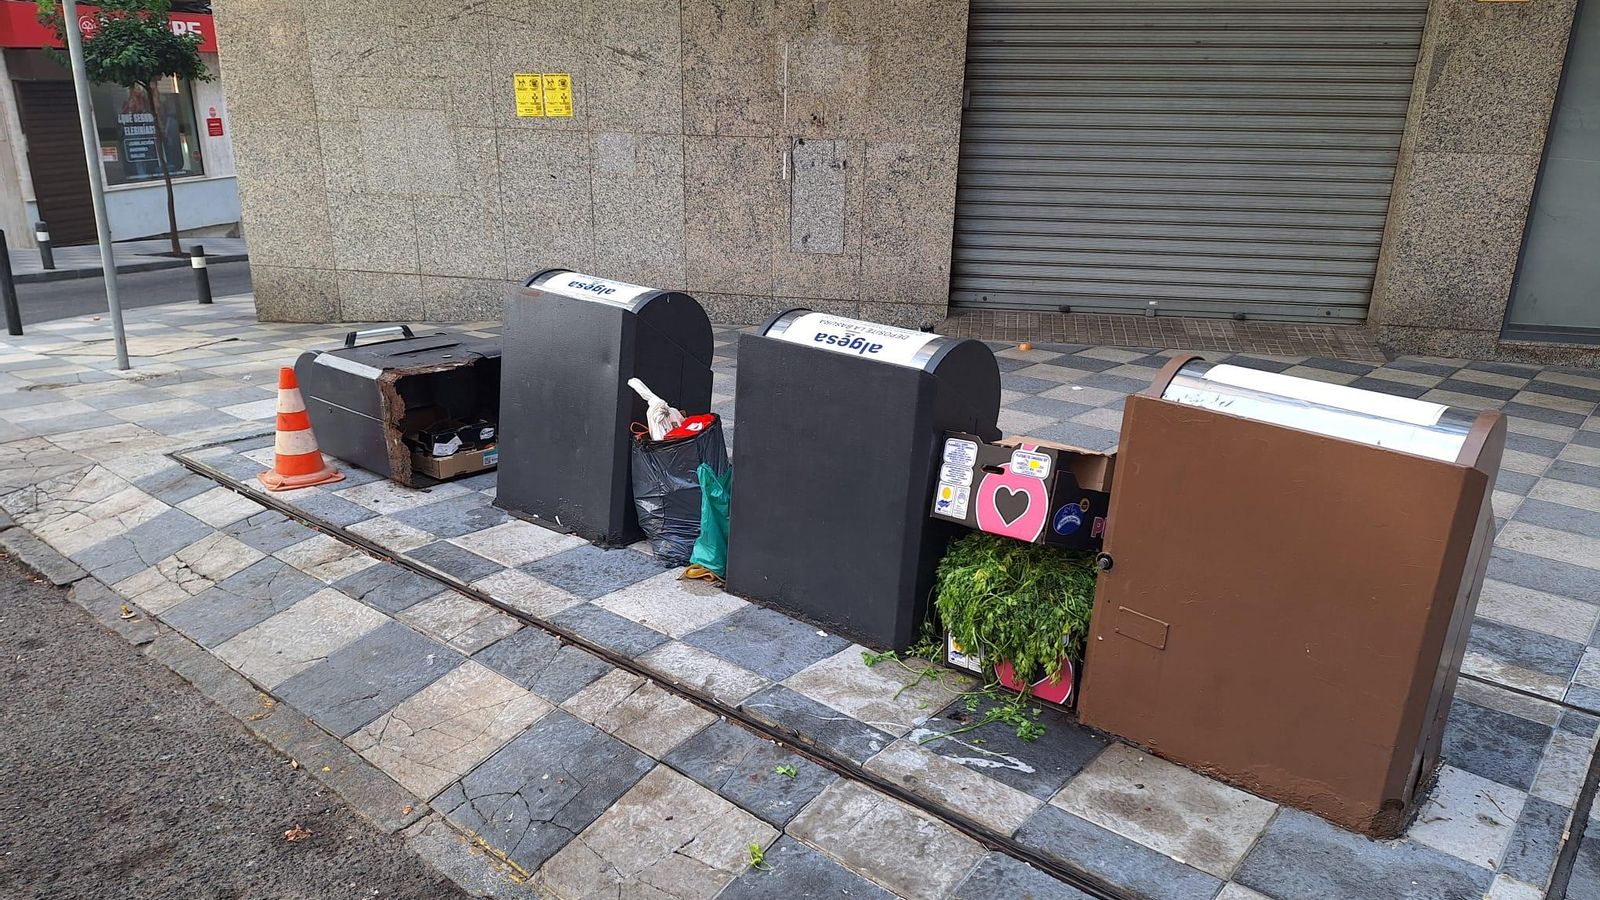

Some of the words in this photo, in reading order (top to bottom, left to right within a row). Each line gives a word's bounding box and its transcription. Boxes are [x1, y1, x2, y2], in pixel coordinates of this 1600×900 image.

[568, 281, 616, 295] algesa
[819, 319, 853, 329] BASURA
[854, 325, 866, 333] LA
[866, 327, 910, 340] DEPOSITE
[814, 332, 883, 354] algesa
